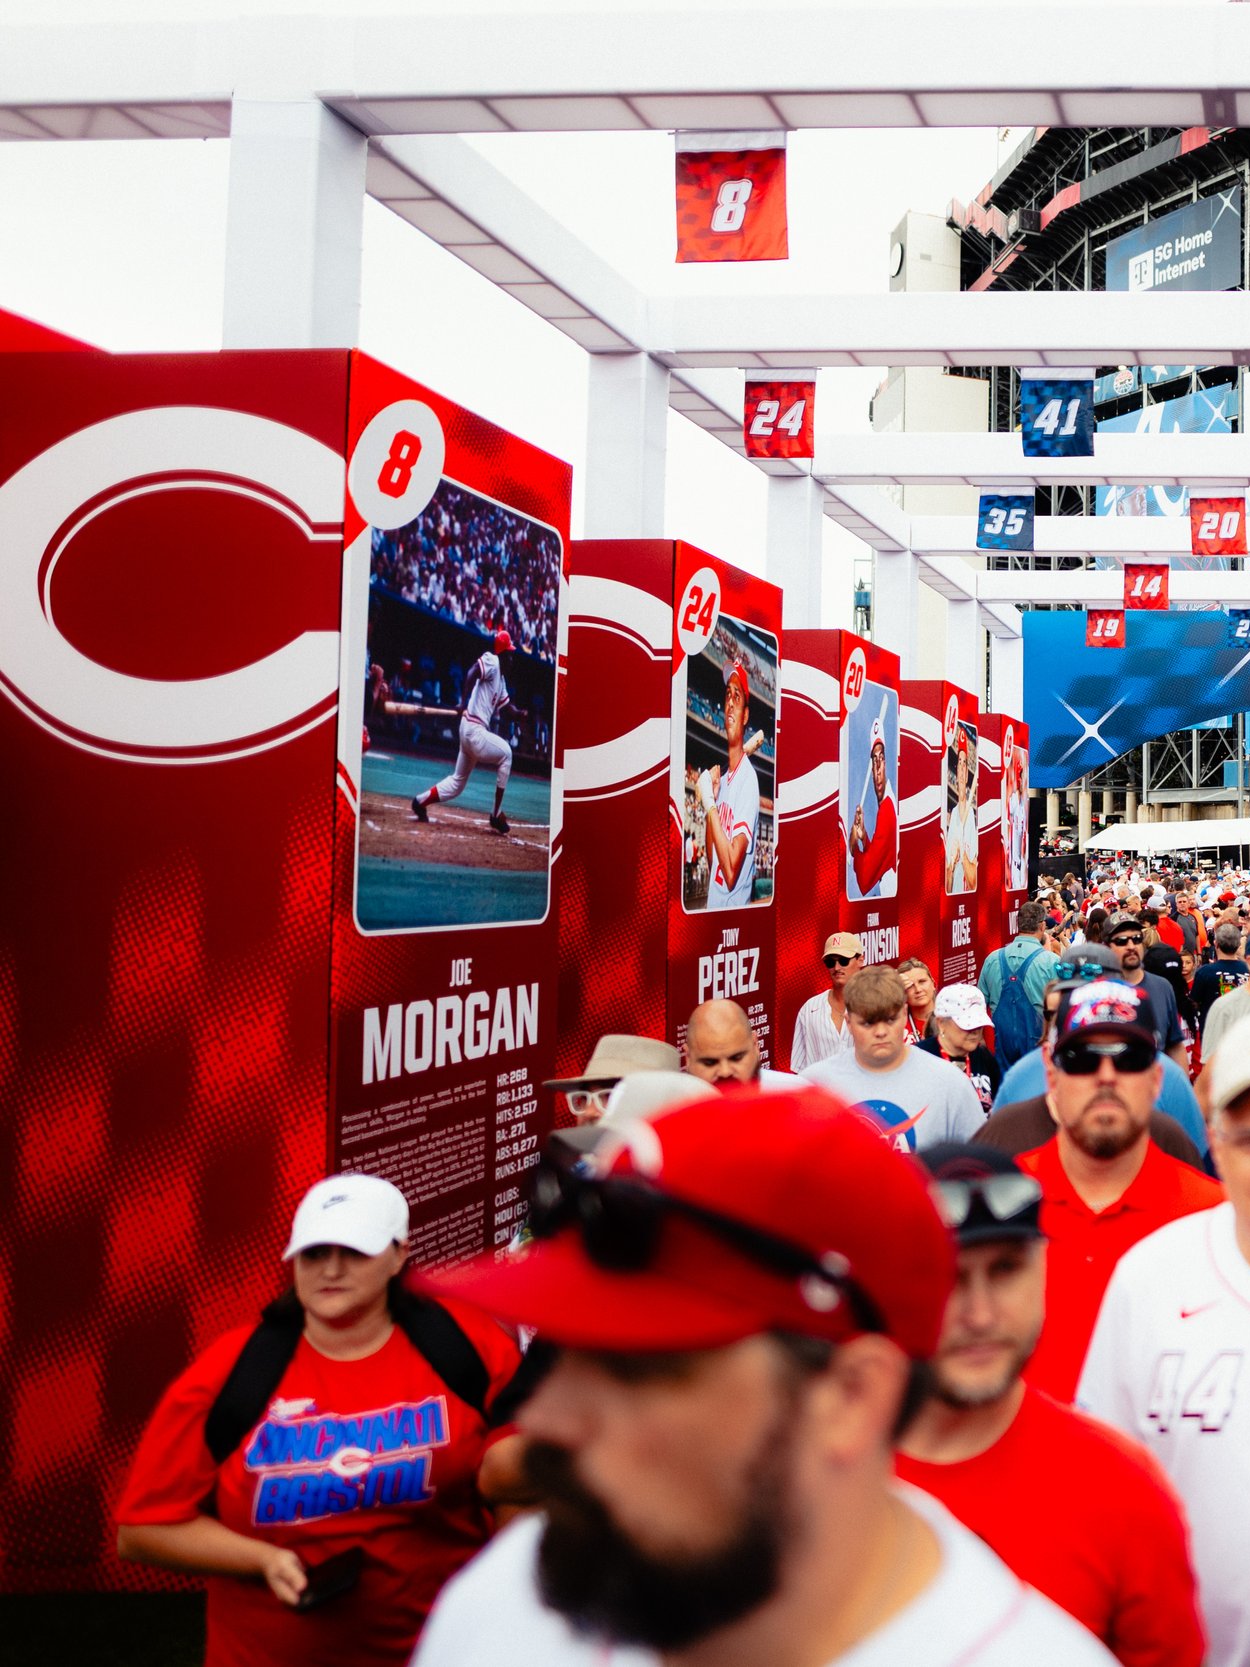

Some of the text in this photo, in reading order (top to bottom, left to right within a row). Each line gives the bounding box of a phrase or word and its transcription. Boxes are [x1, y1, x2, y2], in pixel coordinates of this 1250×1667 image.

[711, 178, 753, 233] 8
[1155, 229, 1213, 263] 5G Home
[1155, 251, 1206, 285] Internet
[749, 400, 806, 436] 24
[1033, 397, 1078, 436] 41
[377, 429, 422, 499] 8
[984, 508, 1024, 537] 35
[1197, 511, 1240, 540] 20
[1130, 575, 1161, 597] 14
[681, 586, 715, 636] 24
[1092, 618, 1119, 637] 19
[845, 665, 863, 698] 20
[947, 705, 956, 734] 14
[722, 928, 739, 947] TONY
[856, 926, 899, 967] BINSON
[952, 916, 971, 948] ROSE
[449, 957, 472, 987] JOE
[698, 943, 760, 1004] PÉREZ
[361, 982, 540, 1086] MORGAN
[497, 1067, 528, 1088] HR: 268
[511, 1084, 533, 1103] 1,133
[495, 1100, 537, 1125] HITS: 2,517
[508, 1122, 526, 1140] .271
[495, 1135, 538, 1162] ABS: 9,277
[495, 1163, 517, 1181] RUNS:
[517, 1151, 541, 1171] 1,650
[494, 1186, 519, 1207] CLUBS:
[494, 1207, 513, 1226] HOU
[494, 1225, 509, 1244] CIN
[1146, 1351, 1244, 1434] 44
[245, 1396, 448, 1473] CINCINNATI
